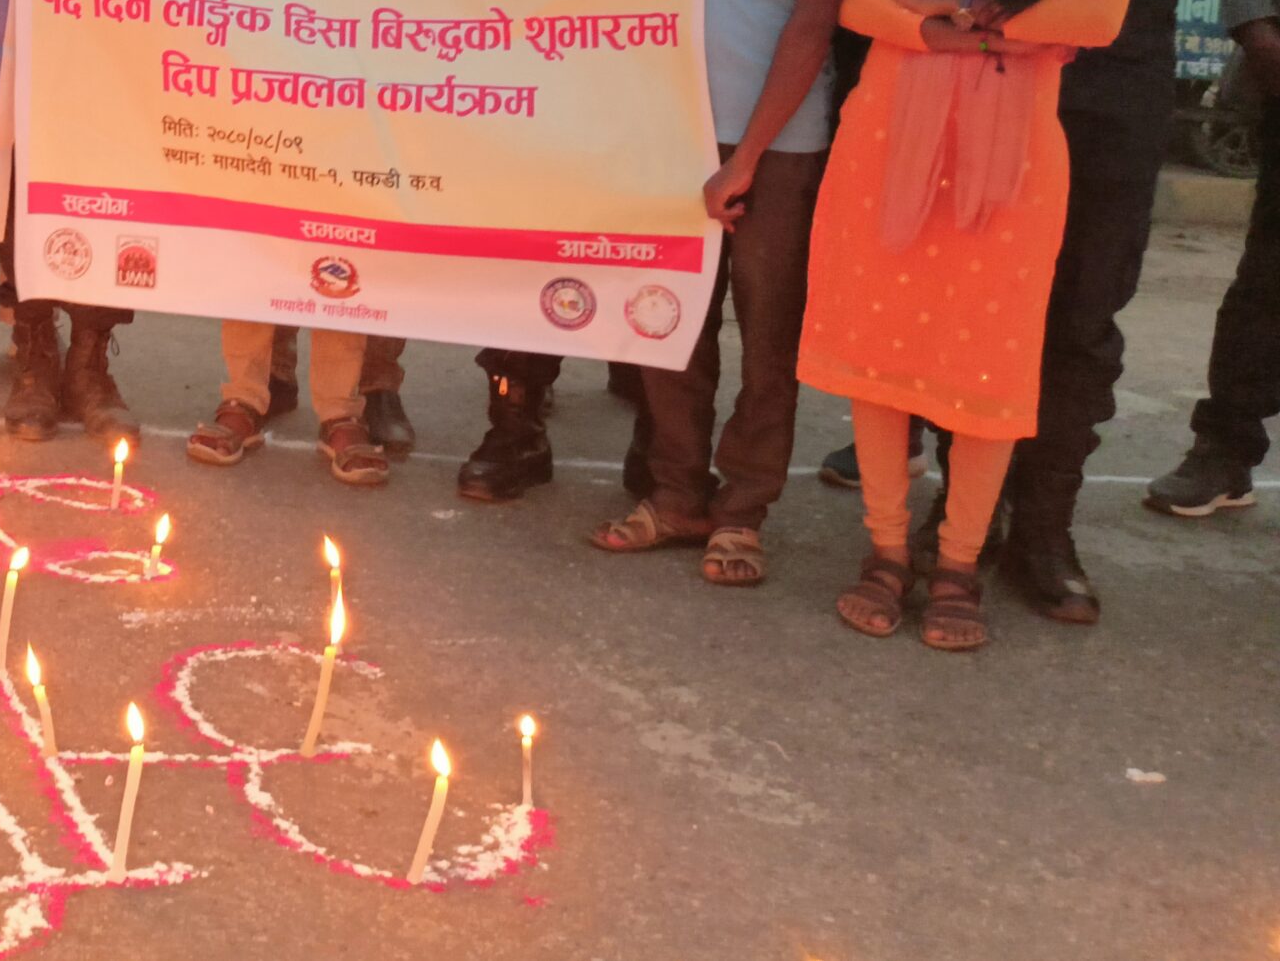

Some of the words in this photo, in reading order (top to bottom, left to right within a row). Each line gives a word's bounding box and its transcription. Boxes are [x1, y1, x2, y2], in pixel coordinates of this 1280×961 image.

[283, 2, 360, 50] हिंसा
[160, 50, 220, 97] दिप
[230, 67, 366, 110] प्रज्वलन
[376, 74, 538, 118] कार्यक्रम
[206, 124, 303, 154] २०८०/०८/०९
[212, 153, 272, 177] मायादेवी
[118, 270, 155, 286] UMN
[269, 297, 317, 316] मायादेवी
